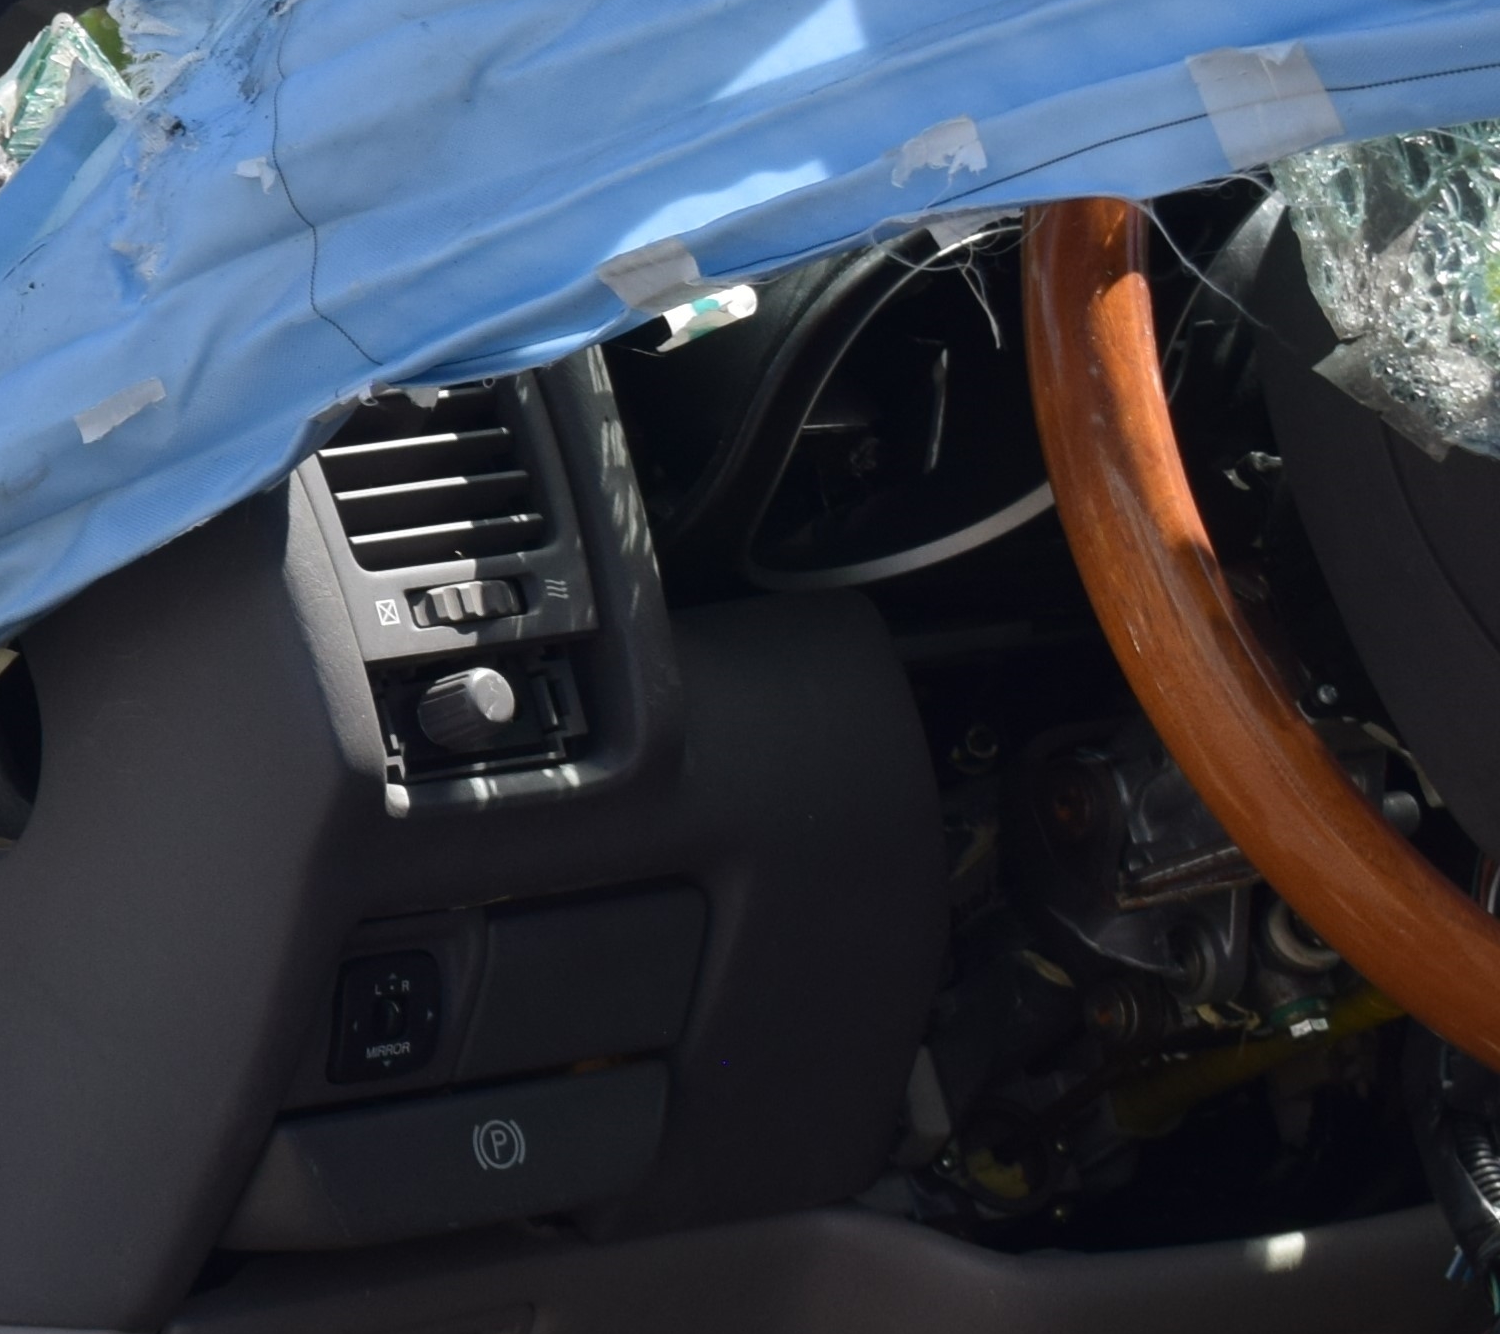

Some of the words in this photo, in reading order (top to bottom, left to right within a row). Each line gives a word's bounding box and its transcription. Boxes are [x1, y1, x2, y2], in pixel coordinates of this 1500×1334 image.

[374, 983, 382, 996] L
[401, 979, 410, 992] R
[366, 1041, 411, 1059] MIRROR
